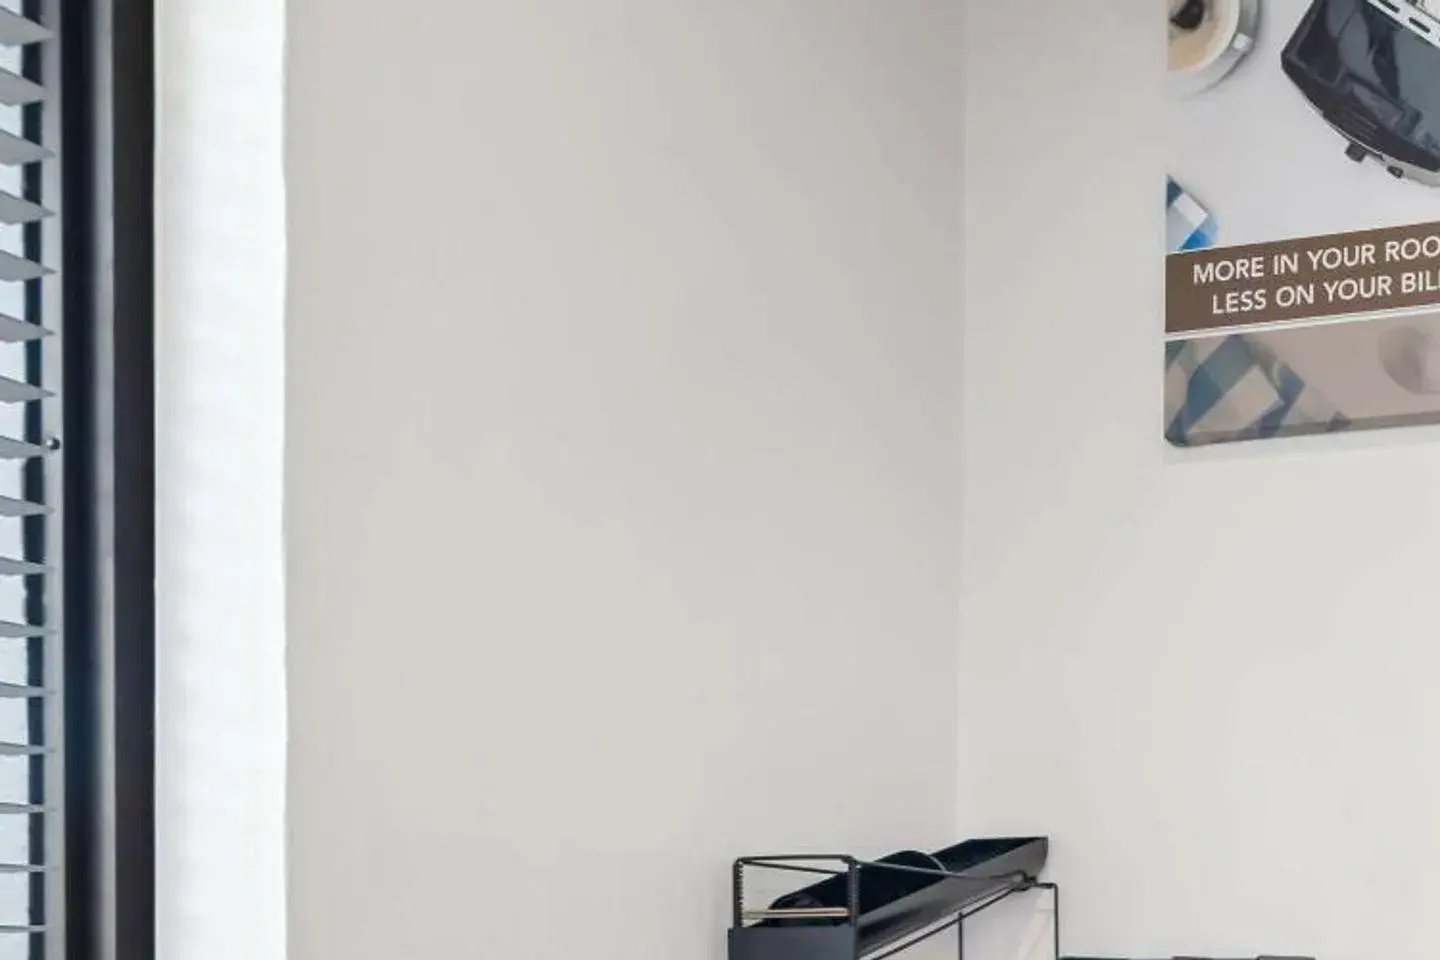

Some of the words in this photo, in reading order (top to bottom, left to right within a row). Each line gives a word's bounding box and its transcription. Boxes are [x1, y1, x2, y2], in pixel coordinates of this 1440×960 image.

[1193, 256, 1264, 285] MORE
[1273, 253, 1300, 275] IN
[1307, 244, 1376, 270] YOUR
[1212, 289, 1267, 314] LESS
[1275, 284, 1315, 307] ON
[1323, 275, 1394, 302] YOUR
